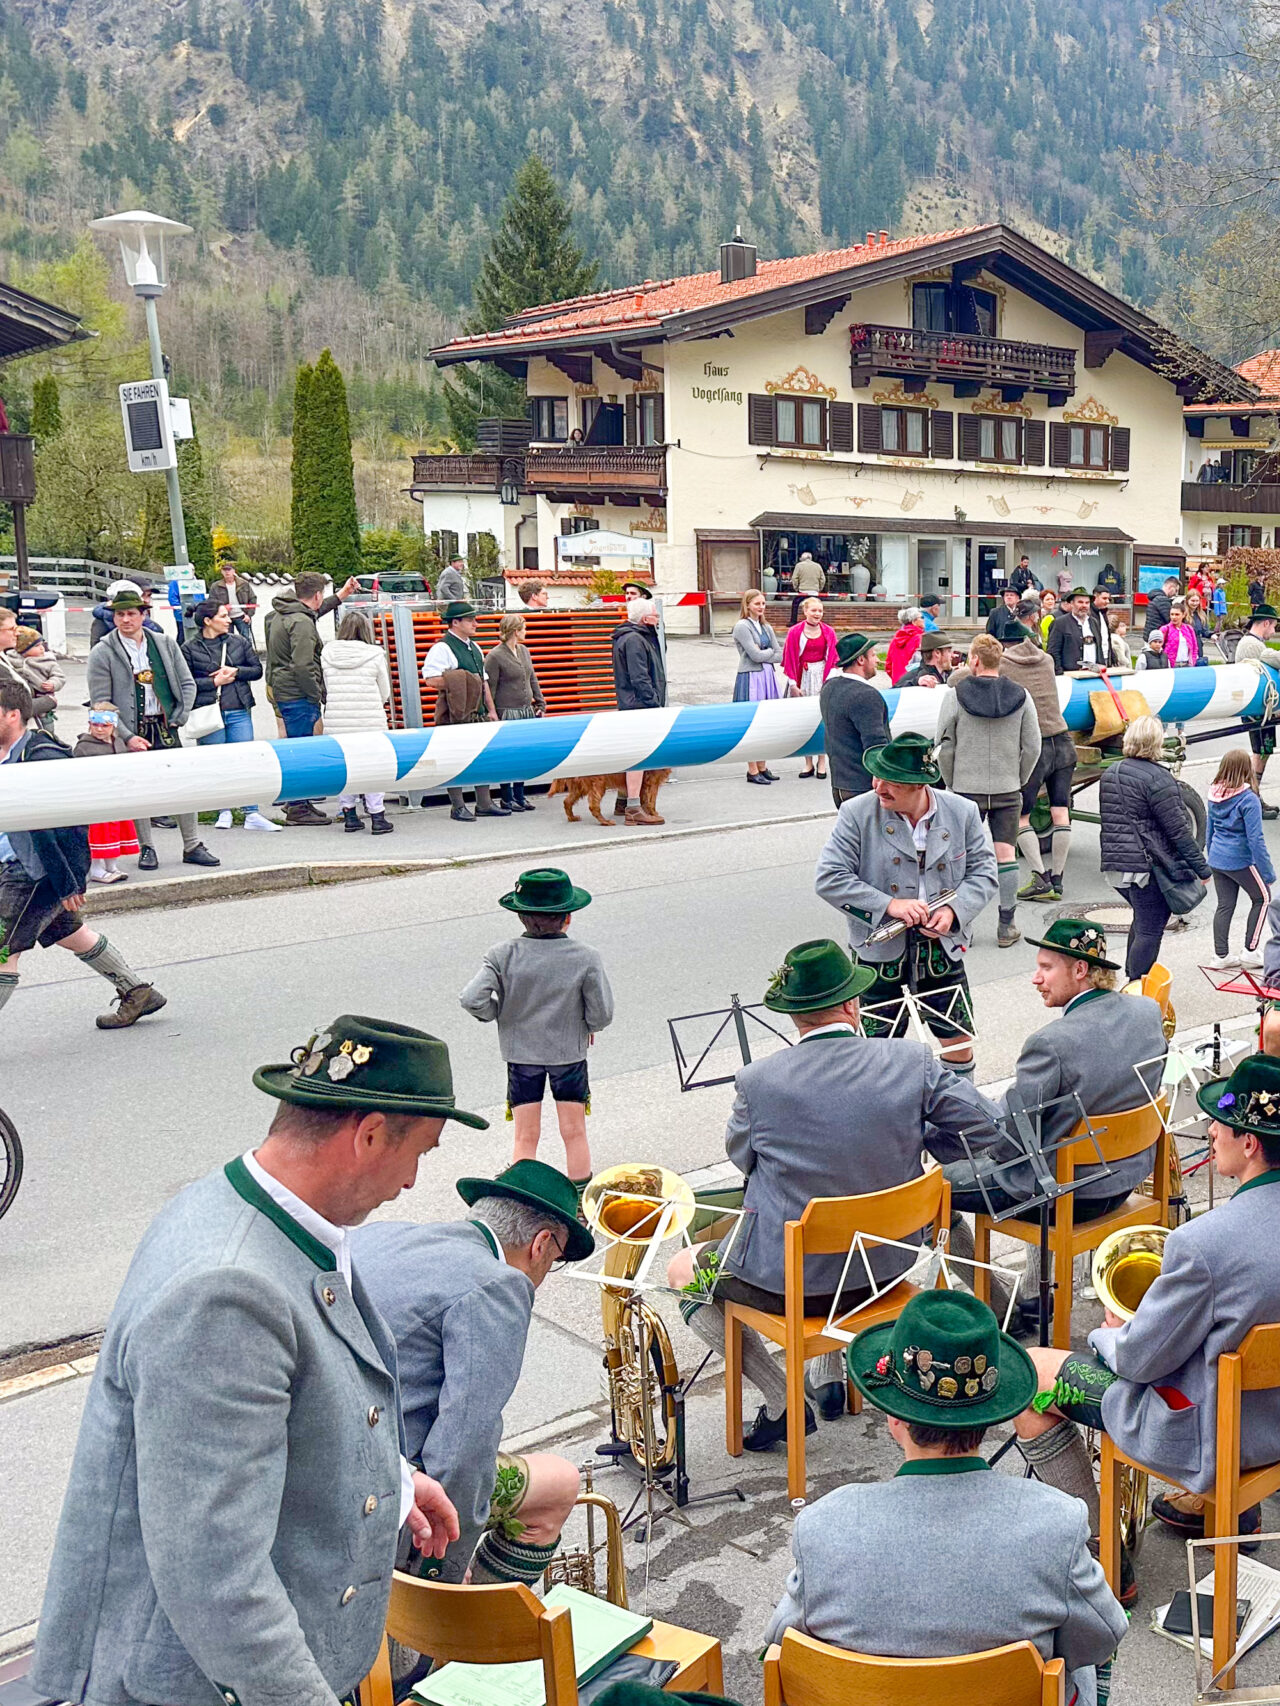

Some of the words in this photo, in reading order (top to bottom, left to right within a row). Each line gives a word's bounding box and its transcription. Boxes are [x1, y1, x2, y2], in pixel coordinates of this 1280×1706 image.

[703, 361, 730, 377] Haus
[122, 387, 133, 402] SIE
[133, 384, 159, 400] FAHREN
[140, 452, 158, 466] km/h
